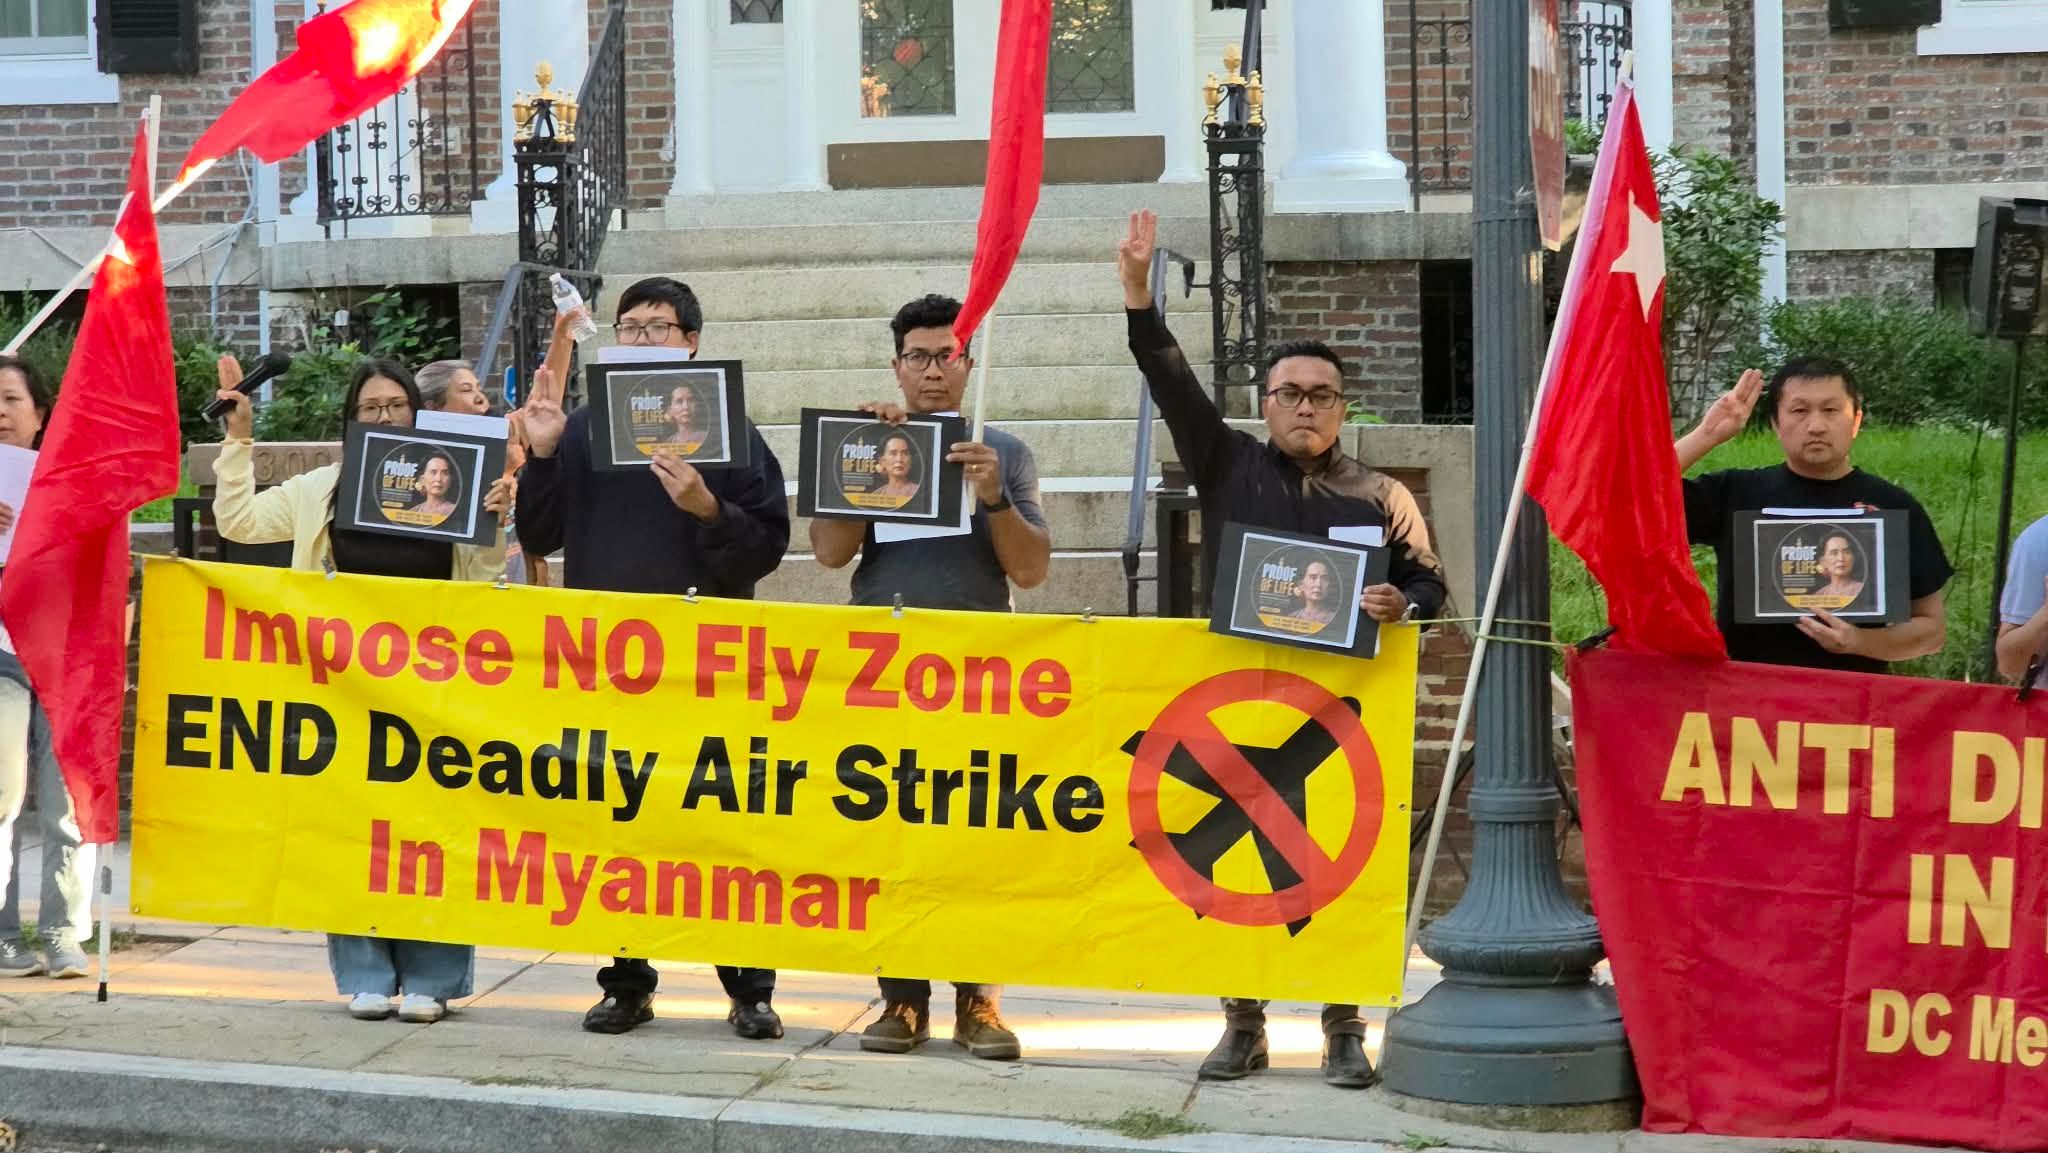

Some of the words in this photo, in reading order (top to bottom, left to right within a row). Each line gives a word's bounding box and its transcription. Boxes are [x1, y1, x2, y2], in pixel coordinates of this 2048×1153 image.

[842, 458, 855, 473] OF
[856, 458, 877, 473] LIFE
[843, 444, 878, 459] PROOF
[1262, 563, 1298, 581] PROOF
[1274, 580, 1296, 596] LIFE
[1781, 546, 1817, 560] PROOF
[206, 588, 513, 685] Impose
[545, 615, 664, 694] NO
[696, 624, 817, 721] Fly
[846, 632, 1072, 717] Zone
[166, 693, 337, 776] END
[367, 710, 659, 822] Deadly
[682, 736, 808, 816] Air
[831, 744, 1105, 833] Strike
[1661, 711, 1895, 818] ANTI
[1949, 730, 2047, 829] DI
[369, 819, 443, 897] In
[476, 828, 879, 930] Myanmar
[1907, 854, 2014, 949] IN
[1866, 989, 1952, 1056] DC
[1969, 995, 2048, 1067] Me
